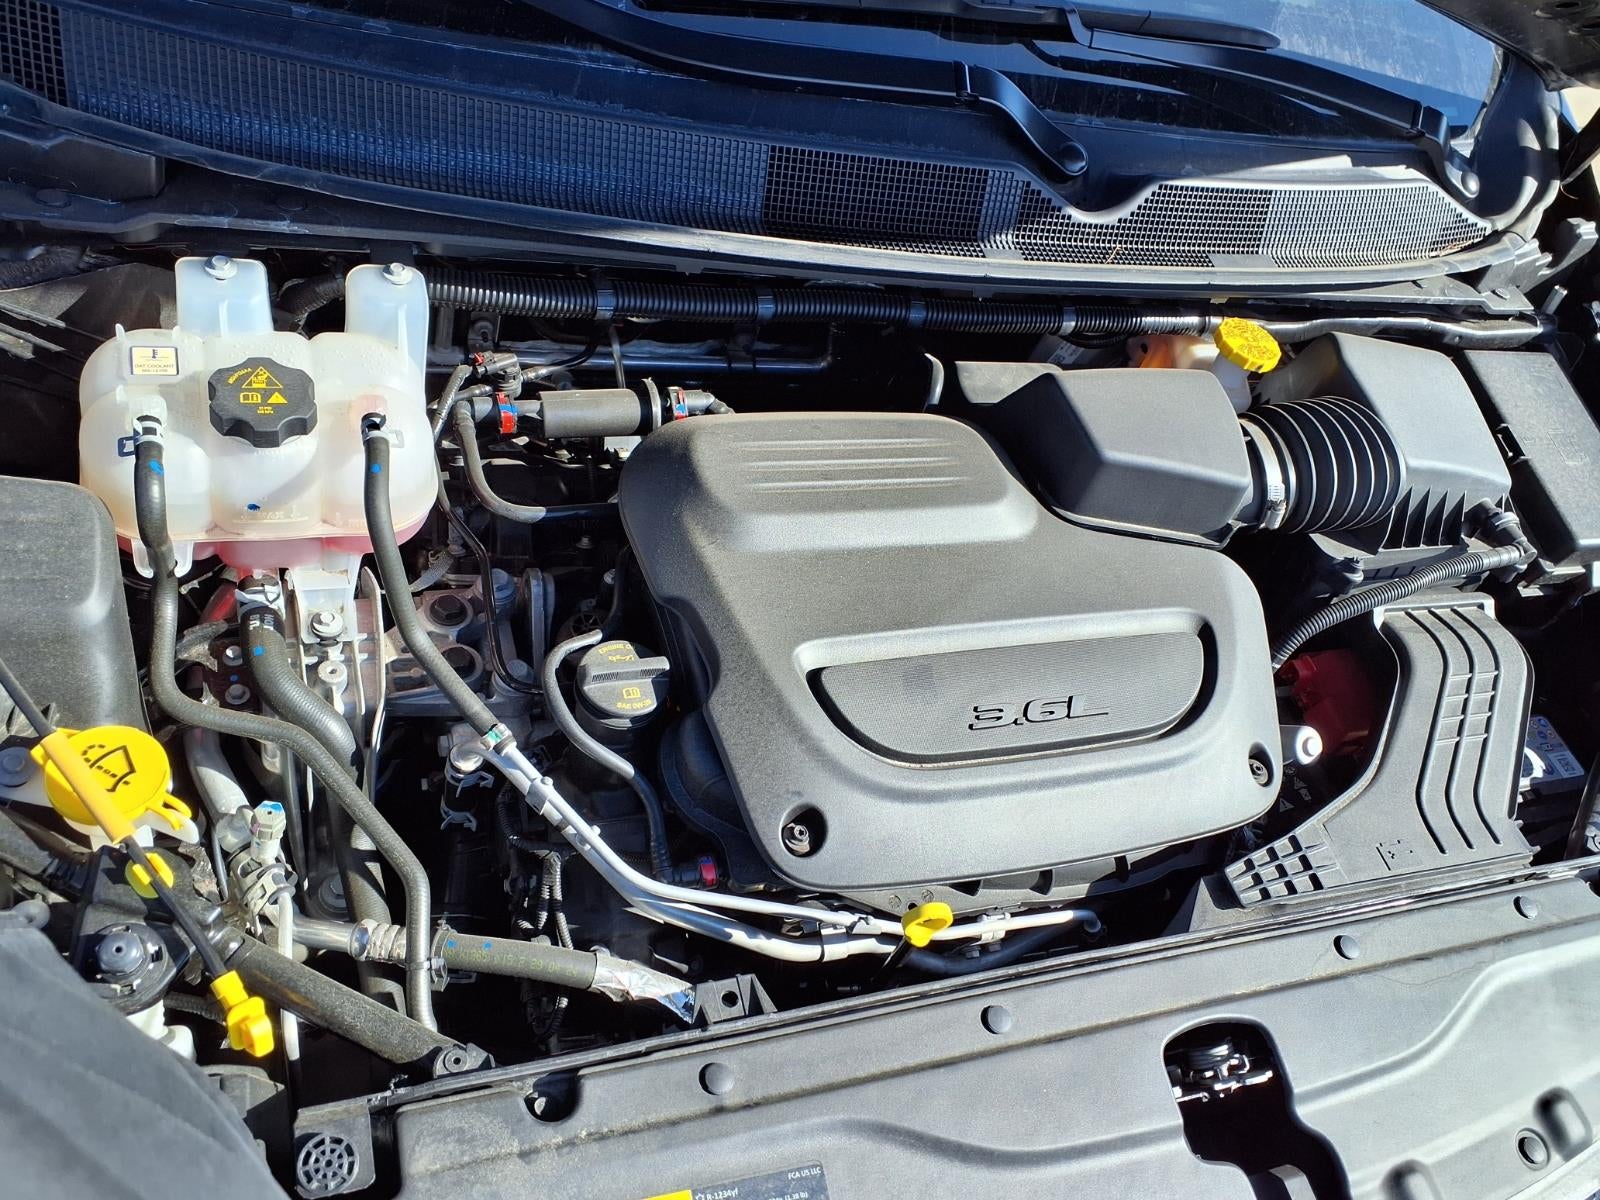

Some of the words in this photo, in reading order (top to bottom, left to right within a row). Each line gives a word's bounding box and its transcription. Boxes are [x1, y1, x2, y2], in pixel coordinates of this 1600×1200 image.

[967, 694, 1110, 731] 3.6L
[788, 1171, 800, 1180] FCA
[801, 1169, 810, 1177] US
[810, 1167, 821, 1175] LLC
[706, 1187, 739, 1200] R-1234yf
